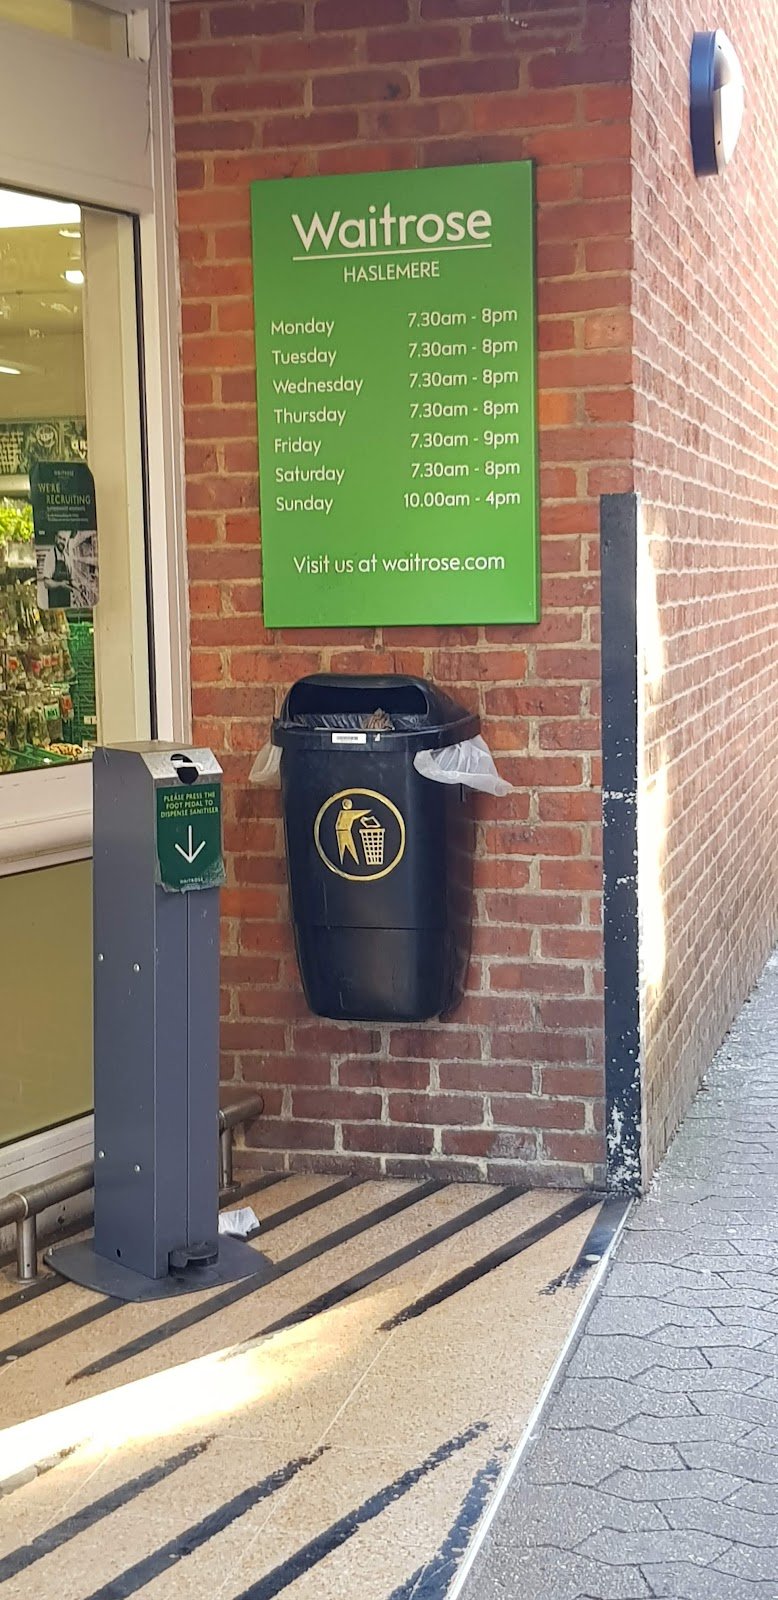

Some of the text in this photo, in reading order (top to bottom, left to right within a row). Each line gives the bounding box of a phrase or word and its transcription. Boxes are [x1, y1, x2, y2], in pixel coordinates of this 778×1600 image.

[292, 202, 491, 252] Waitrose
[344, 261, 439, 282] HASLEMERE
[272, 317, 335, 338] Monday
[408, 312, 466, 328] 7.30am
[482, 308, 518, 327] 8pm
[272, 347, 337, 368] Tuesday
[409, 342, 467, 358] 7.30am
[482, 339, 518, 358] 8pm
[273, 376, 364, 396] Wednesday
[409, 372, 467, 388] 7.30am
[483, 369, 518, 389] 8pm
[274, 406, 346, 427] Thursday
[410, 403, 468, 419] 7.30am
[483, 400, 519, 420] 8pm
[274, 437, 322, 457] Friday
[411, 433, 469, 449] 7.30am
[484, 430, 519, 449] 9pm
[275, 465, 345, 486] Saturday
[411, 463, 469, 478] 7.30am
[484, 461, 520, 480] 8pm
[46, 494, 91, 505] RECRUITING
[276, 495, 334, 515] Sunday
[403, 492, 470, 508] 10.00am
[486, 490, 520, 510] 4pm
[293, 553, 505, 574] Visit us at waitrose.com
[164, 793, 184, 802] PLEASE
[186, 792, 203, 800] PRESS
[166, 799, 213, 810] FOOT PEDAL TO
[160, 807, 219, 818] DISPENSE SANITISER
